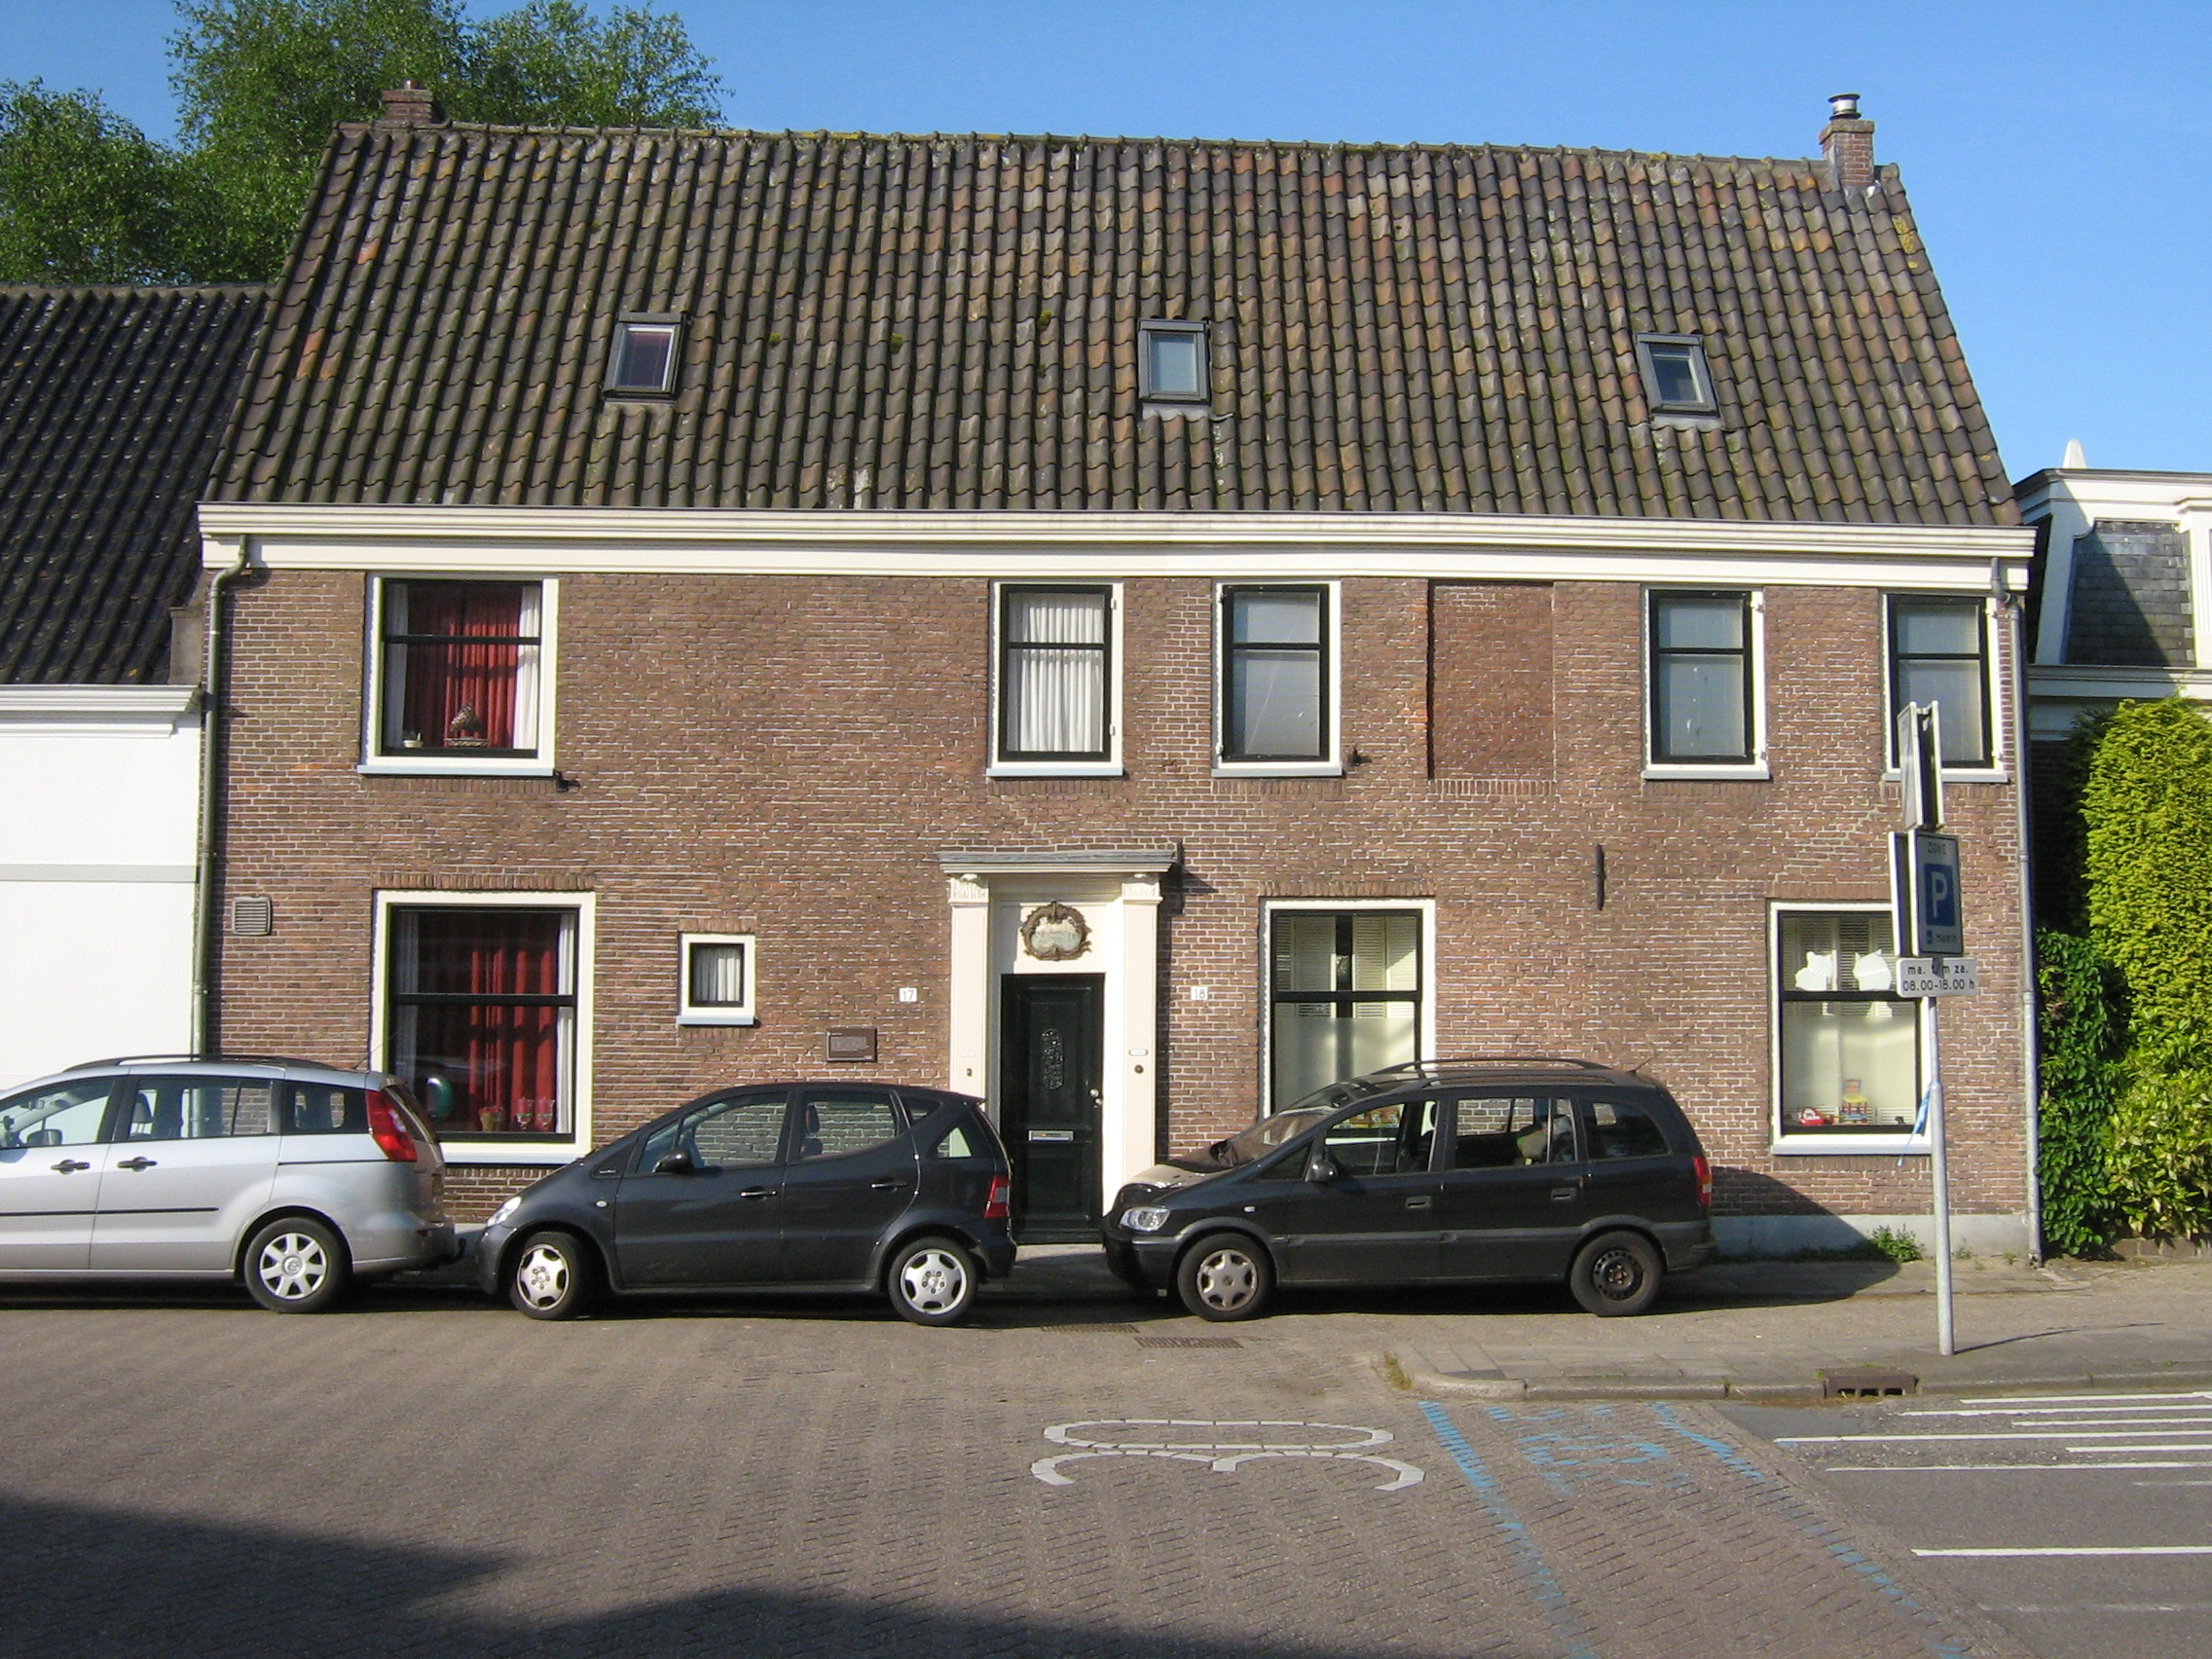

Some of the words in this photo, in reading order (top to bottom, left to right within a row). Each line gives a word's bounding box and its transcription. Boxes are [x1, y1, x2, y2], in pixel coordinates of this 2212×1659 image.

[1932, 871, 1947, 918] P
[1907, 966, 1926, 975] ma.
[1954, 965, 1969, 974] za.
[1902, 978, 1966, 991] 08.00-18.00
[1969, 978, 1974, 989] h
[902, 989, 915, 1002] 17
[1194, 988, 1206, 999] 18
